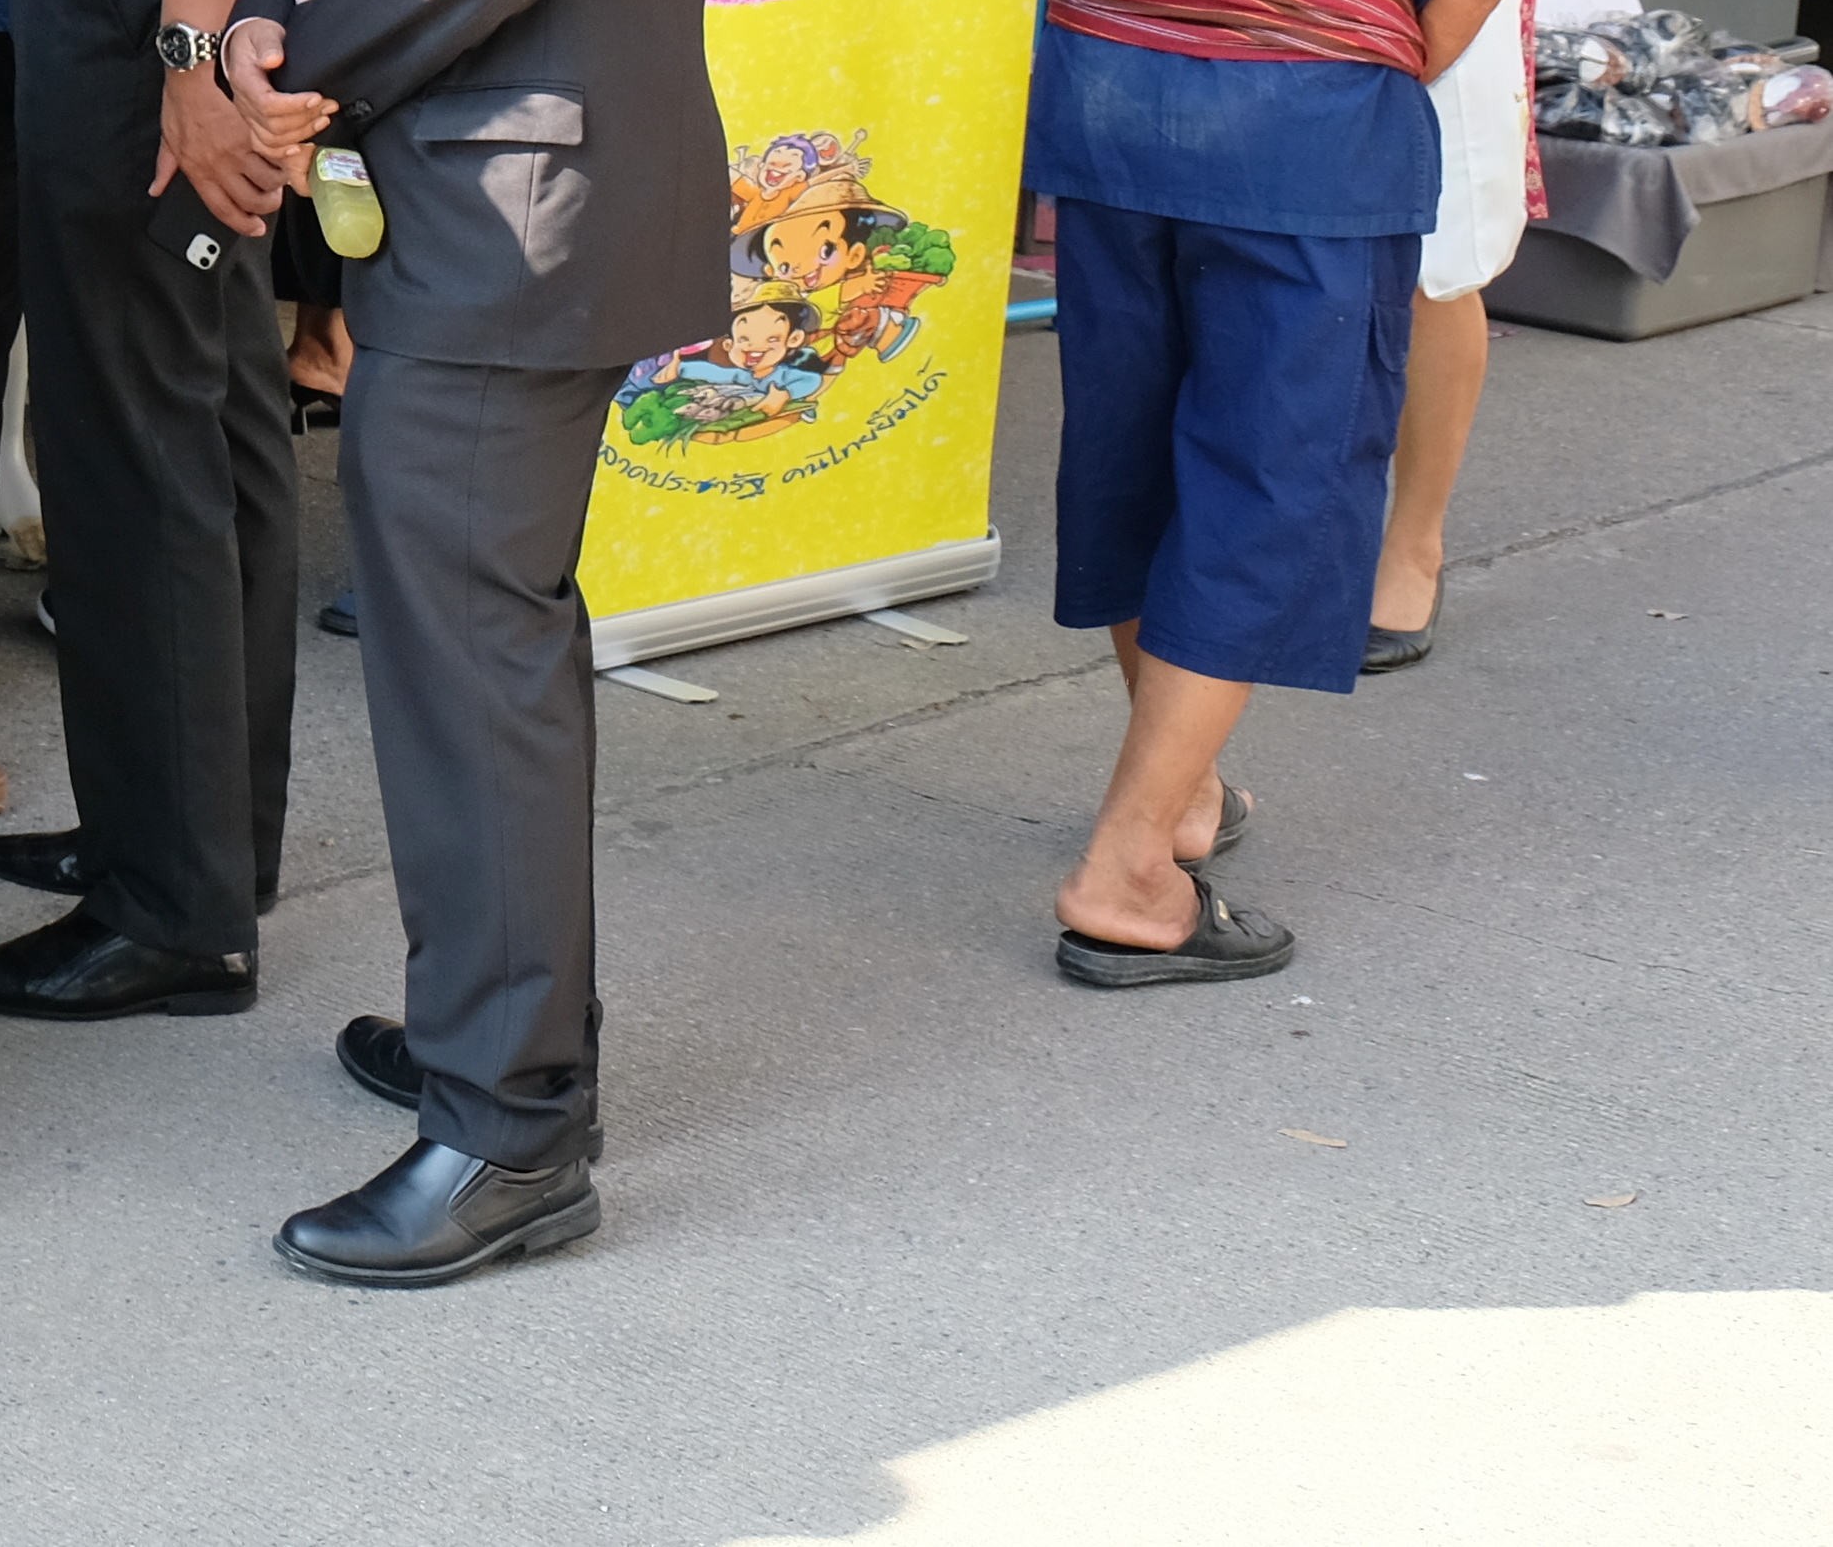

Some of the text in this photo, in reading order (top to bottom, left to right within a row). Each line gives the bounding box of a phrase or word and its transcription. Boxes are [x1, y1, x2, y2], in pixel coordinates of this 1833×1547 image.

[598, 439, 772, 500] ลาดประชารัฐ
